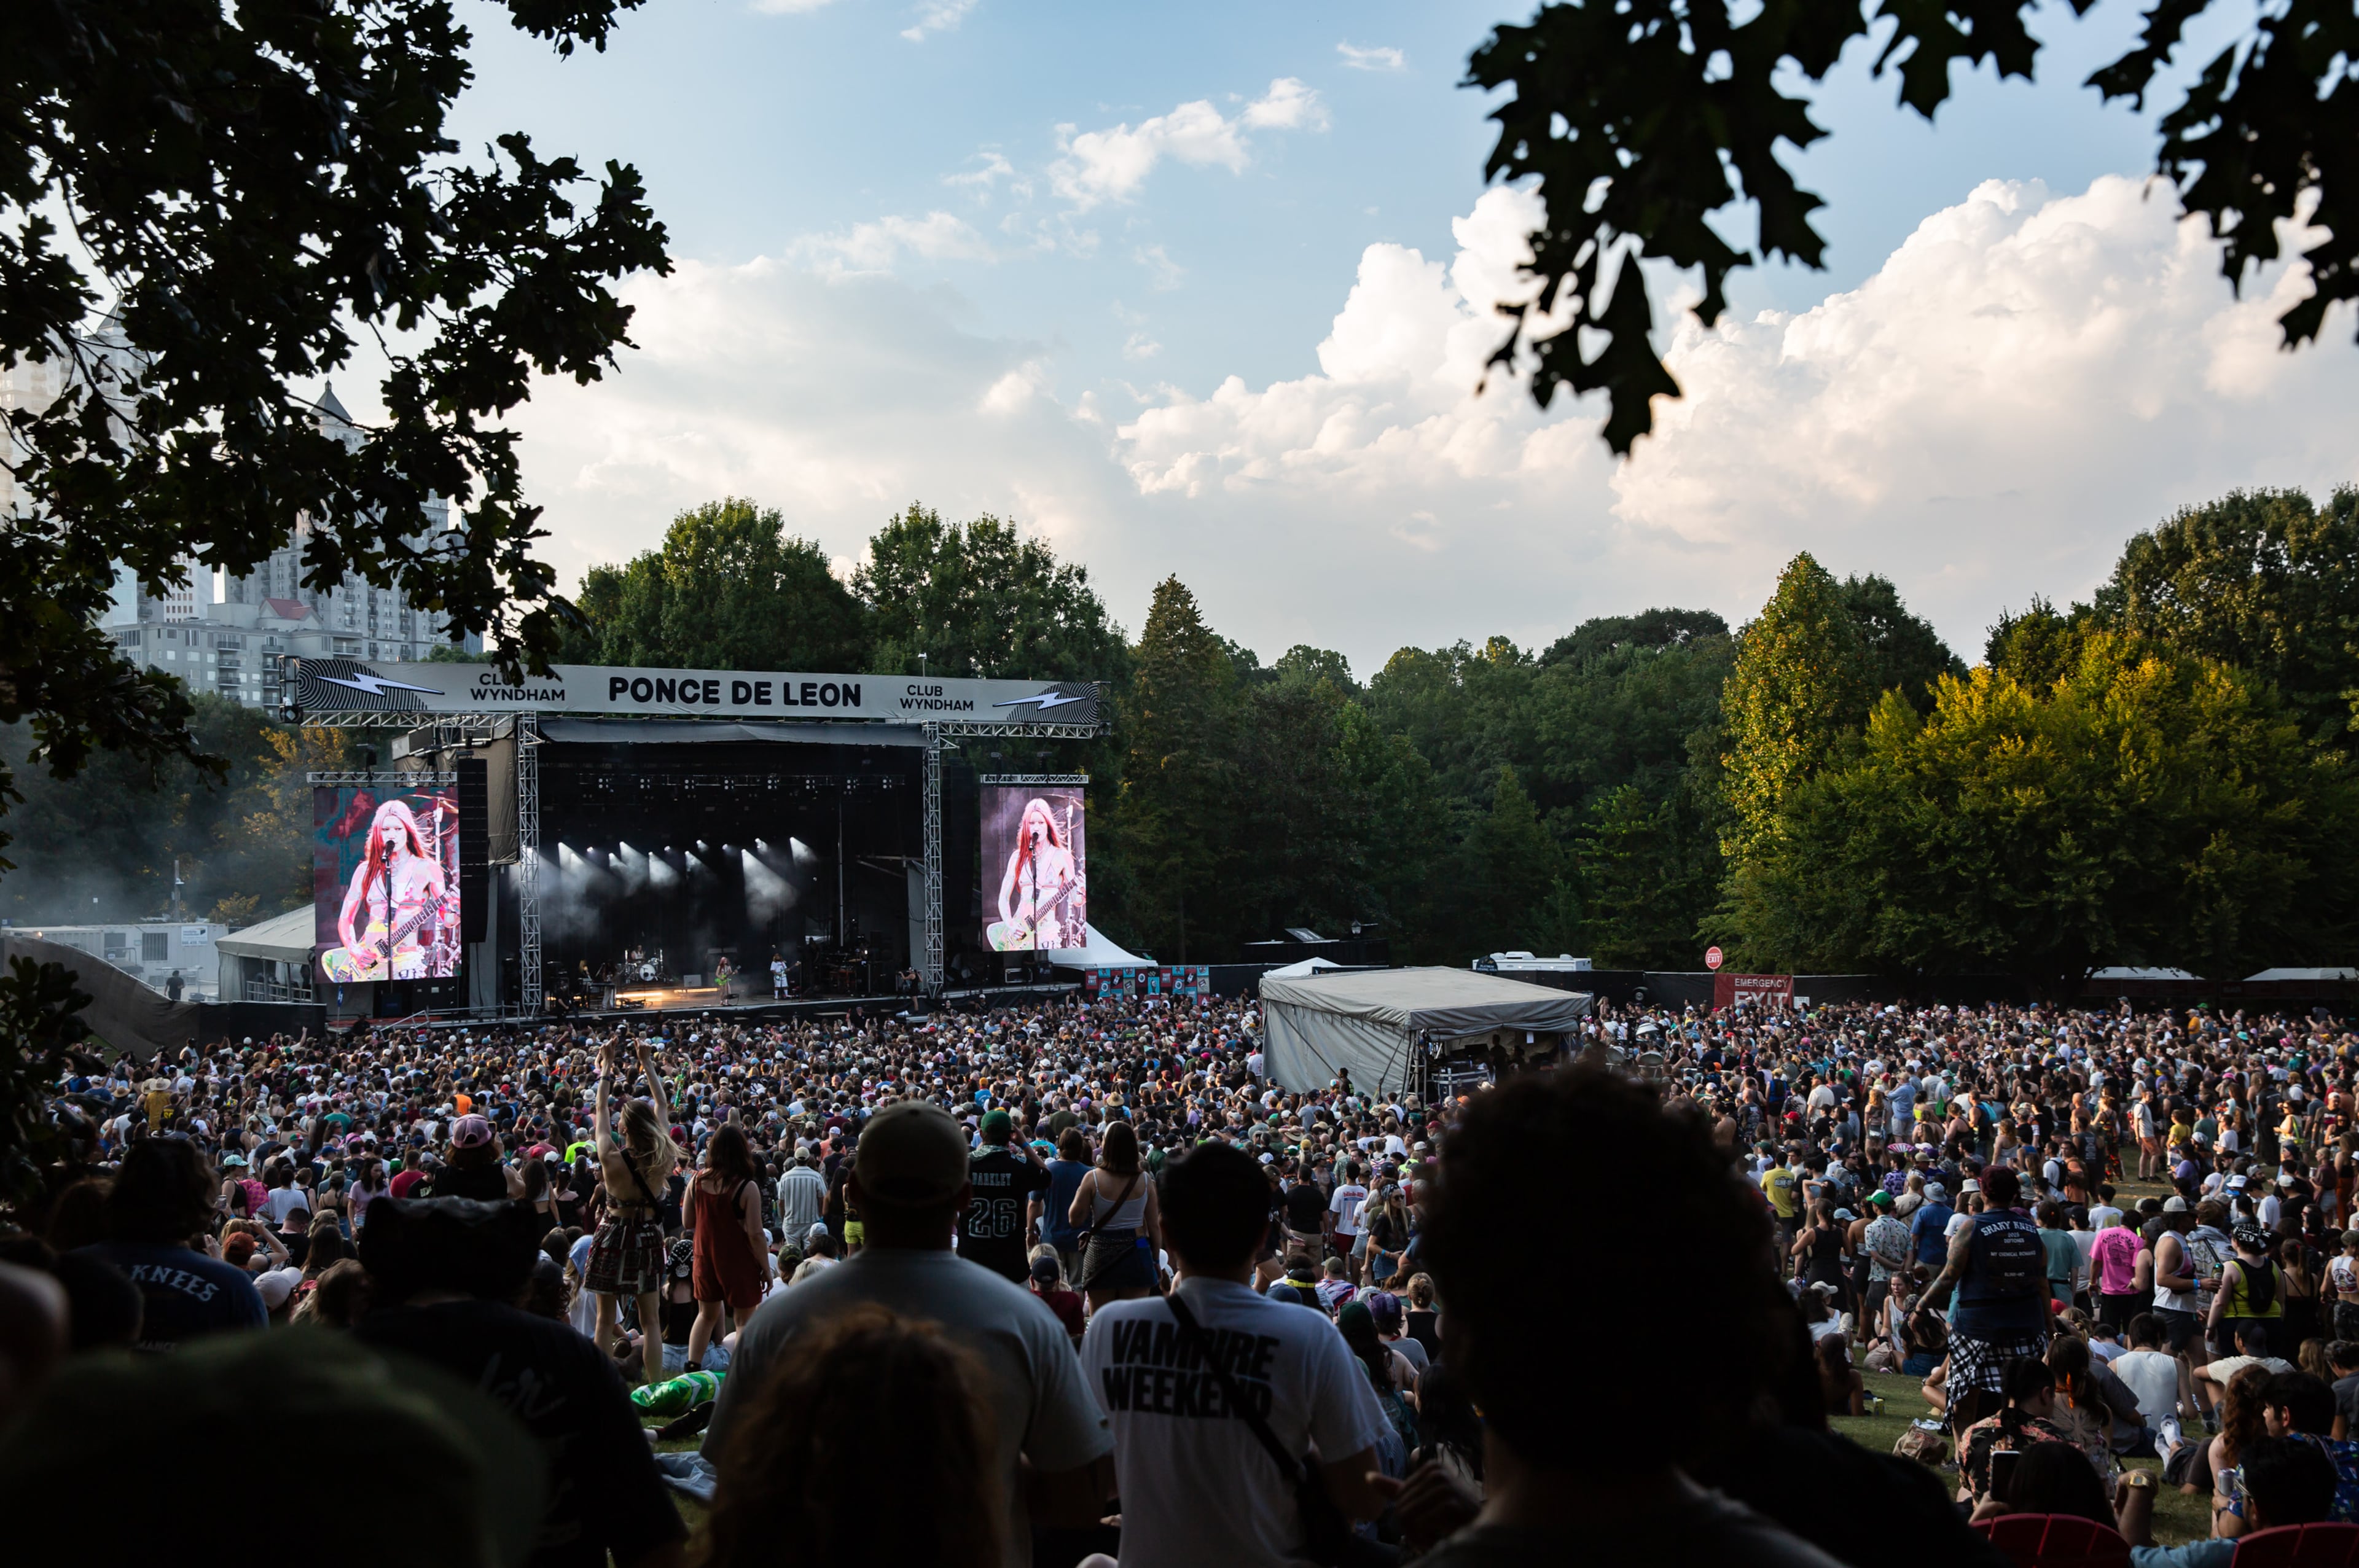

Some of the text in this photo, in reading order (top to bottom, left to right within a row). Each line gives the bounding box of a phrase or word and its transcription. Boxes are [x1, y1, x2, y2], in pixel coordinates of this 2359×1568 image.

[479, 673, 525, 686] CL
[471, 688, 565, 701] WYNDHAM
[609, 677, 861, 708] PONCE DE LEON
[907, 685, 943, 696] CLUB
[900, 698, 974, 711] WYNDHAM
[1734, 978, 1788, 988] EMERGENCY
[1734, 991, 1788, 1010] EXIT
[972, 1172, 1012, 1187] BARKLEY
[969, 1198, 1017, 1238] 26
[1981, 1221, 2011, 1236] SHAKY
[130, 1264, 221, 1302] KNEES
